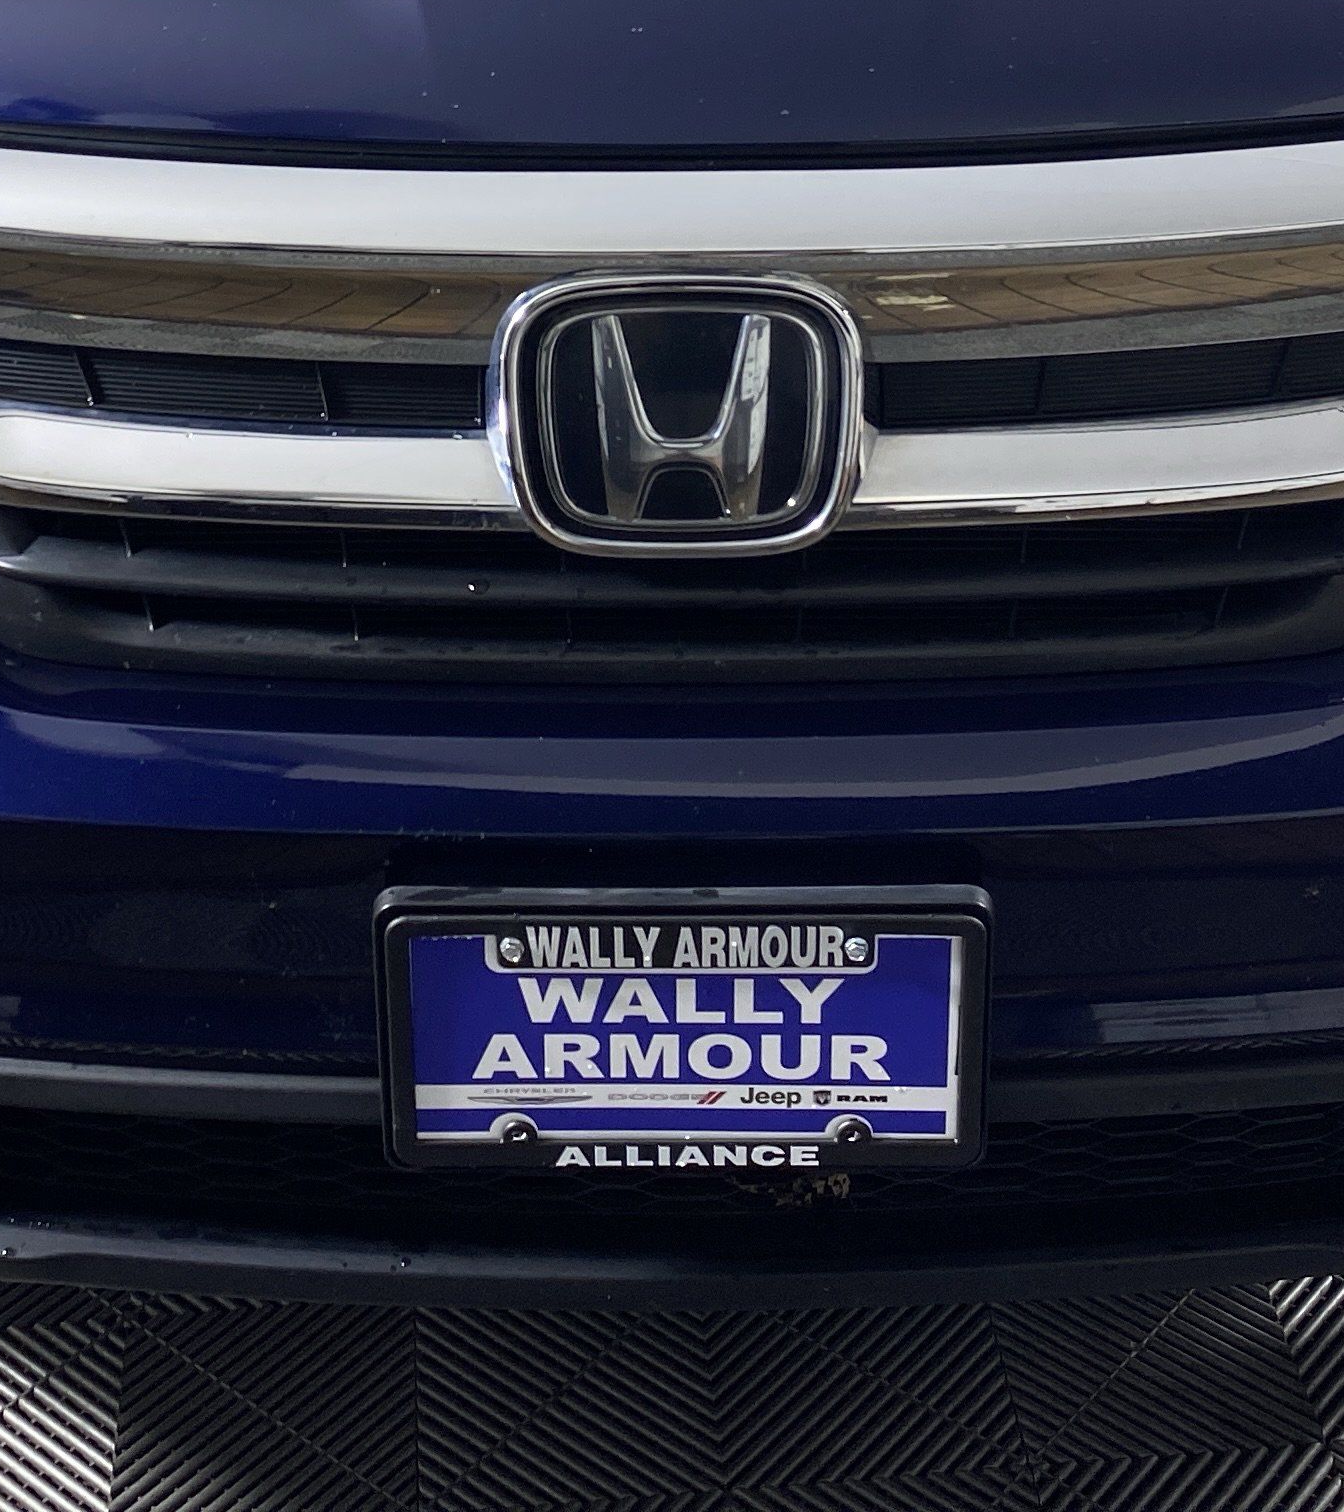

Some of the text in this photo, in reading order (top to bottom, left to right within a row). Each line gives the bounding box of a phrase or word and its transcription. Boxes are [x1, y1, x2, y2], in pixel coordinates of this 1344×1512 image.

[525, 924, 845, 968] WALLY ARMOUR
[517, 977, 846, 1024] WALLY
[471, 1032, 892, 1081] ARMOUR
[607, 1093, 704, 1101] DODGE
[739, 1087, 802, 1108] Jeep
[836, 1094, 889, 1103] RAM
[555, 1144, 820, 1167] ALLIANCE
